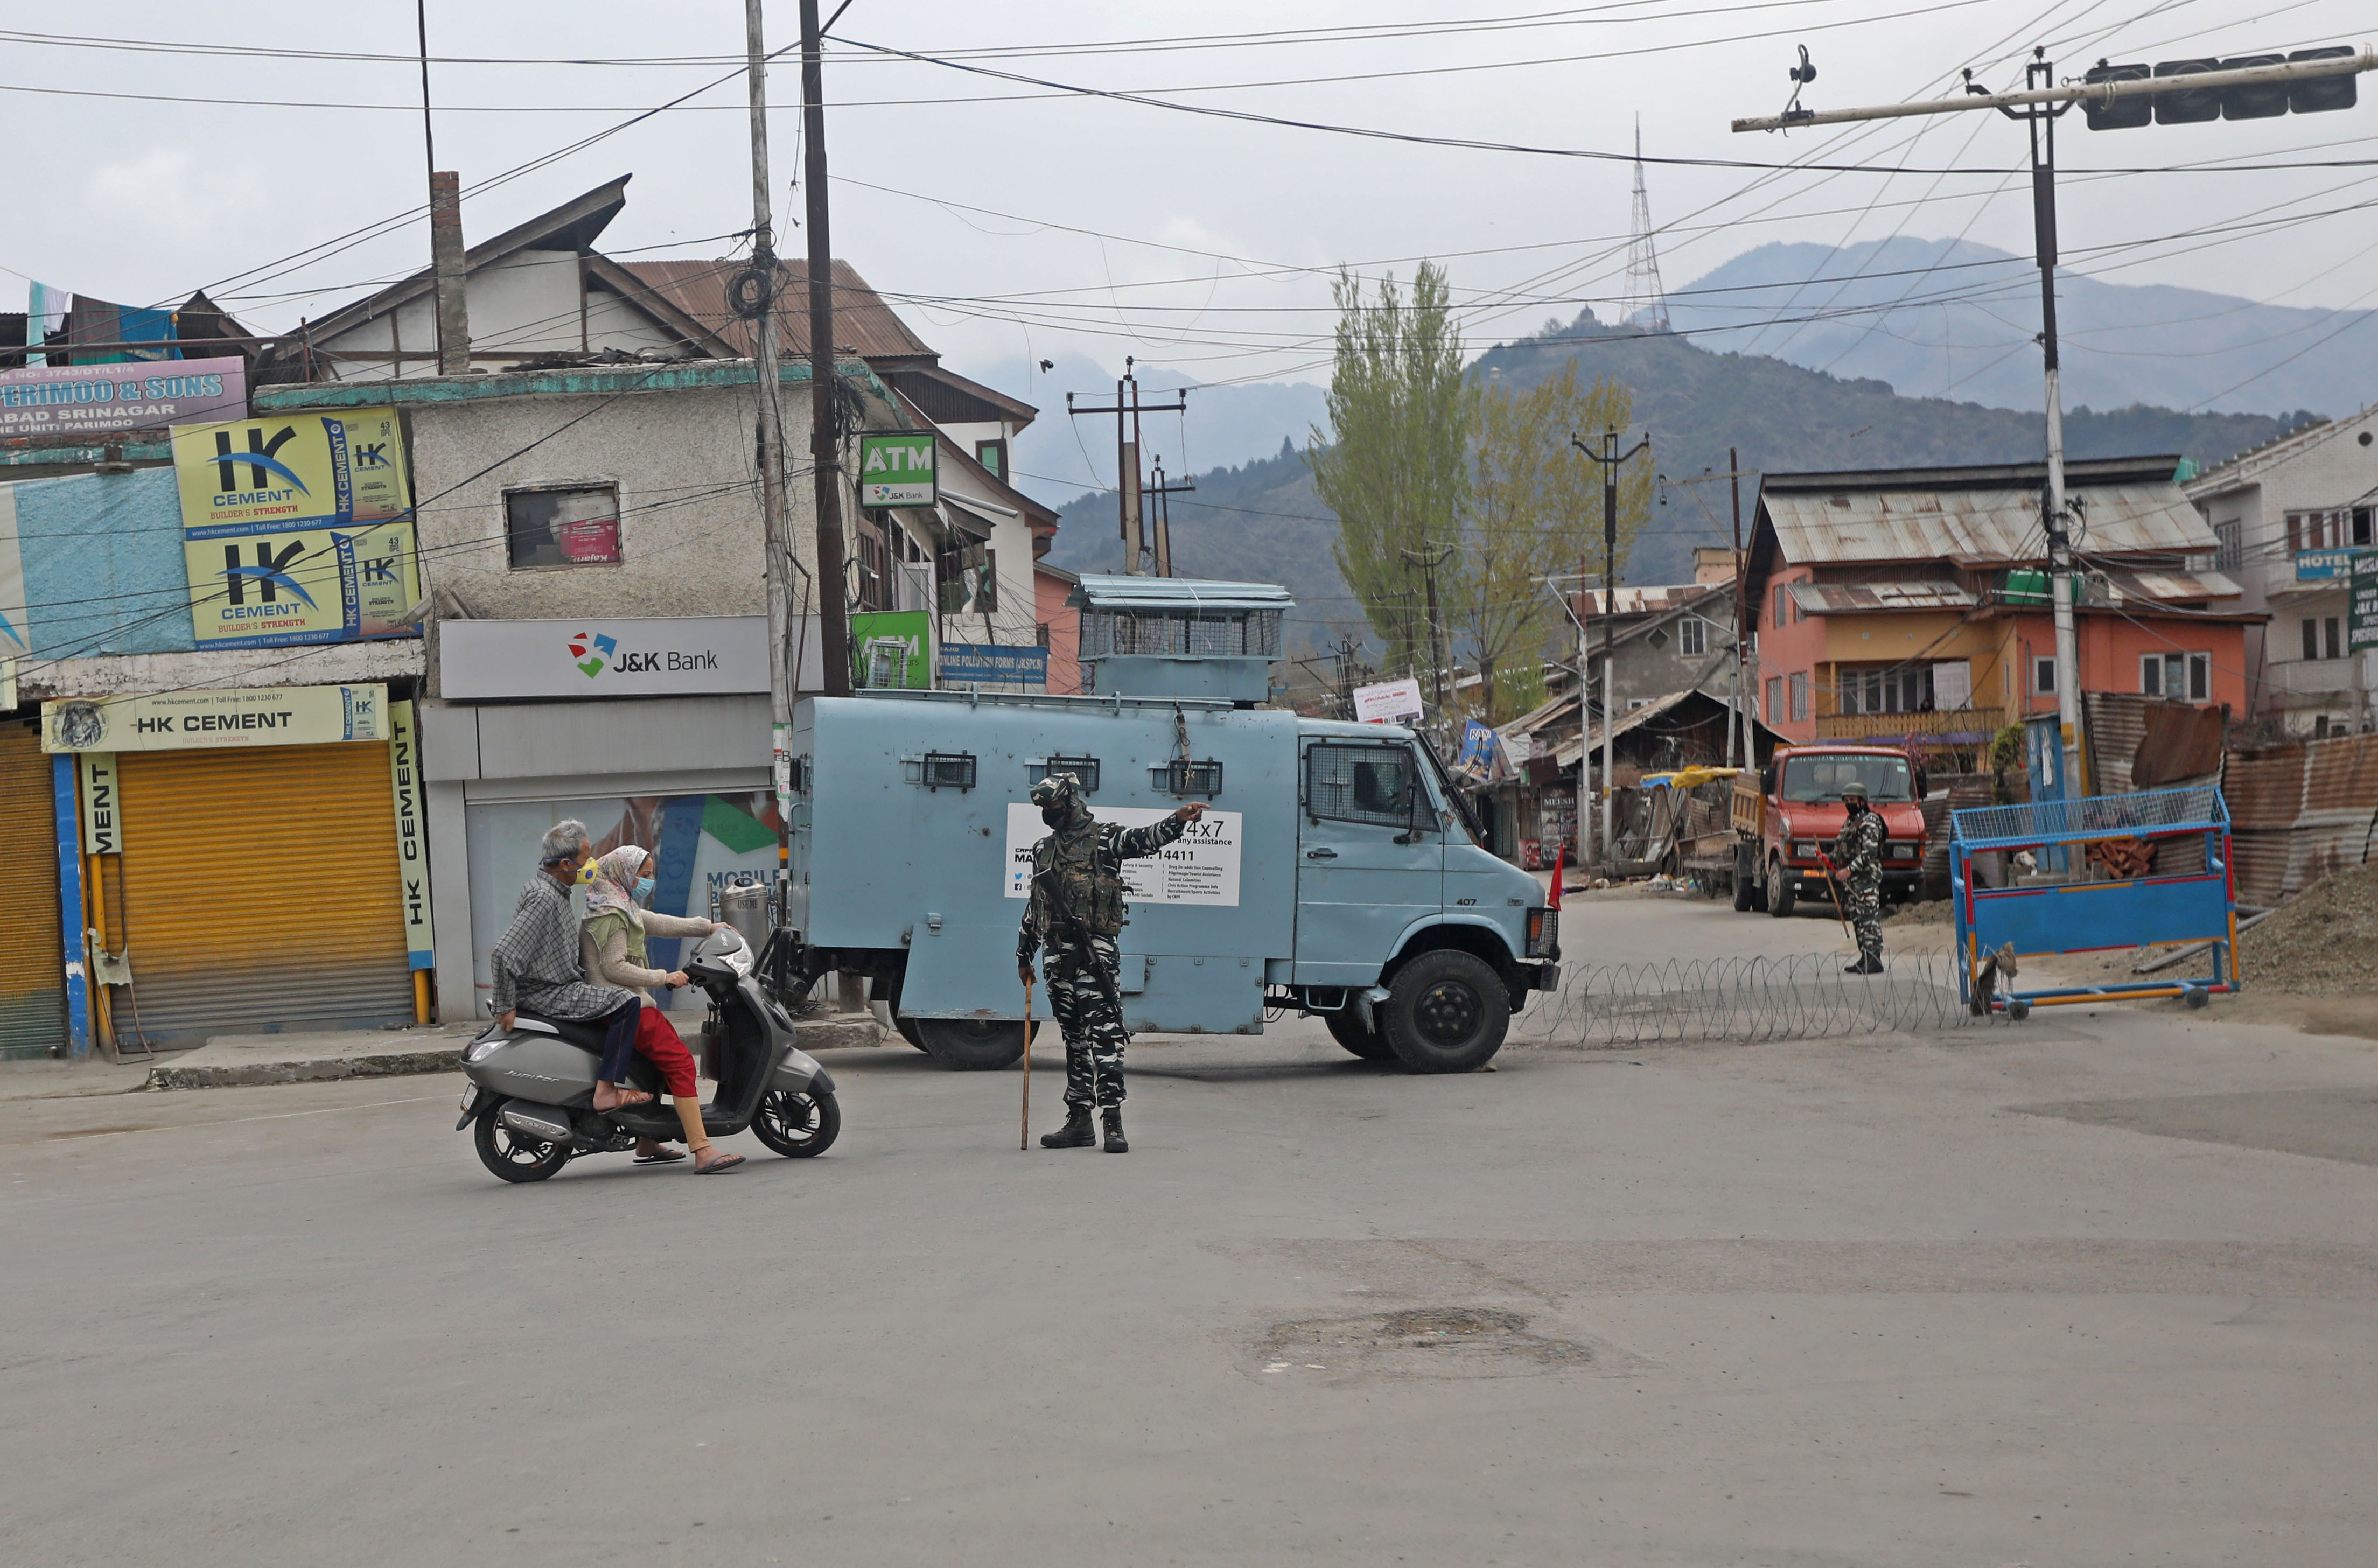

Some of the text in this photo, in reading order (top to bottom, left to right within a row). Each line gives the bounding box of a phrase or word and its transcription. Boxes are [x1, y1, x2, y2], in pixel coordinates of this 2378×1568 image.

[15, 370, 40, 379] NO:
[0, 374, 223, 408] ERIMOO & SONS
[0, 404, 176, 424] BAD SRINAGAR
[19, 423, 59, 432] UNIT:
[65, 419, 134, 430] PARIMOO
[380, 421, 390, 430] 43
[215, 425, 297, 492] HK
[355, 443, 386, 466] HK
[864, 446, 932, 471] ATM
[333, 436, 349, 512] HK CEMENT
[214, 489, 293, 507] CEMENT
[210, 505, 298, 519] BUILDER'S STRENGTH
[192, 526, 249, 537] www.hkcement.com
[282, 521, 296, 529] 1800
[389, 537, 399, 545] 43
[2299, 554, 2351, 569] HOTEL
[225, 540, 305, 605] HK
[363, 558, 394, 582] HK
[341, 552, 356, 627] HK CEMENT
[221, 603, 301, 620] CEMENT
[218, 619, 306, 633] BUILDER'S STRENGTH
[199, 639, 257, 649] www.hkcement.com
[613, 650, 718, 673] J&K Bank
[894, 659, 919, 667] Hurs
[939, 655, 960, 666] ONLINE
[995, 656, 1015, 669] FORMS
[151, 697, 209, 706] www.hkcement.com
[356, 701, 372, 712] HK
[138, 712, 292, 733] HK CEMENT
[1469, 728, 1492, 740] RANI
[394, 721, 423, 925] HK CEMENT
[1186, 820, 1224, 838] 4x7
[1193, 837, 1232, 846] assistance
[1158, 850, 1194, 861] 14411
[738, 899, 758, 909] USE ME
[503, 1070, 561, 1083] Jupiter
